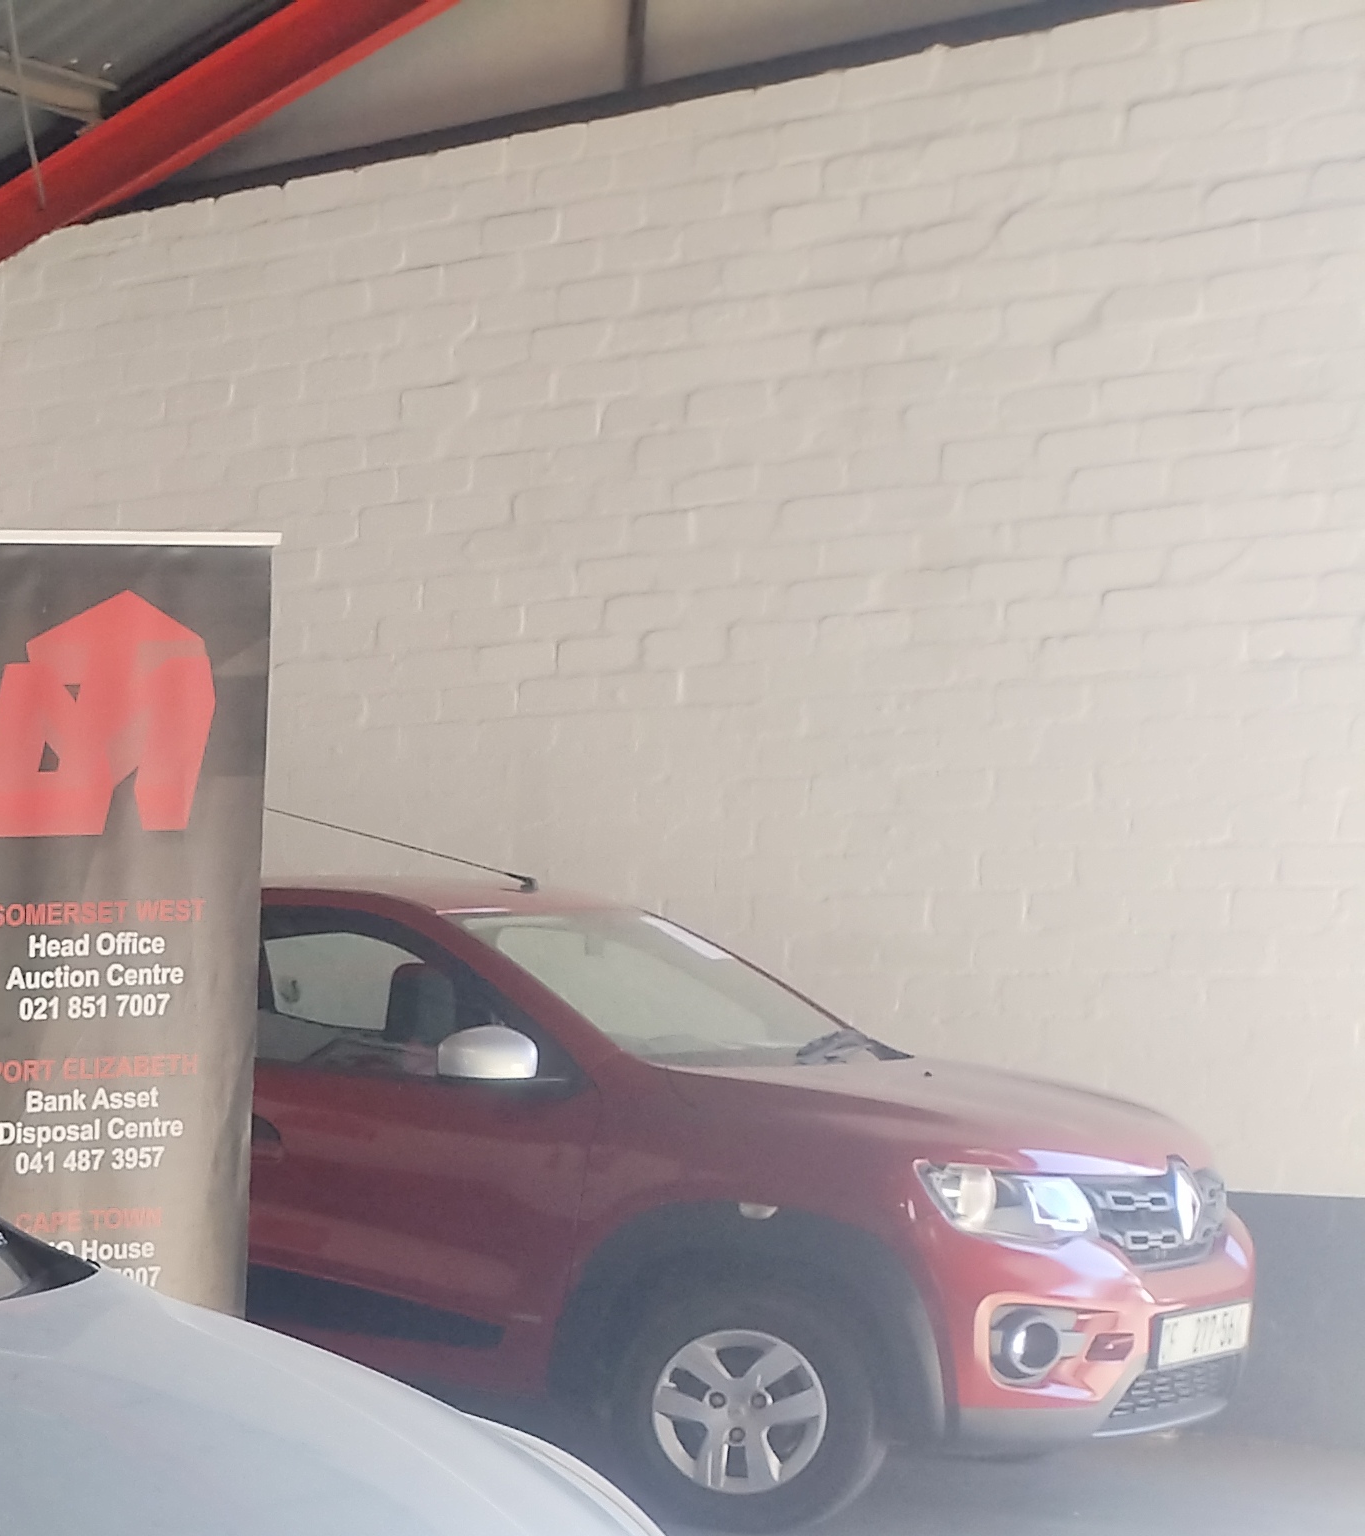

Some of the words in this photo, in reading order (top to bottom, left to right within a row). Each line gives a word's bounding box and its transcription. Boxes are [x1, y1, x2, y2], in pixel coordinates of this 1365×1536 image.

[137, 898, 206, 922] WEST
[28, 933, 89, 958] Head
[96, 931, 165, 956] Office
[5, 965, 99, 990] Auction
[106, 963, 184, 987] Centre
[18, 996, 59, 1021] 021
[67, 995, 107, 1019] 851
[116, 993, 170, 1017] 7007
[63, 1054, 198, 1080] ELIZABETH
[26, 1088, 87, 1113] Bank
[92, 1086, 159, 1110] Asset
[107, 1116, 183, 1140] Centre
[15, 1150, 54, 1175] 041
[63, 1148, 105, 1172] 487
[111, 1146, 164, 1170] 3957
[15, 1209, 82, 1234] CAPE
[89, 1207, 163, 1231] TOWN
[81, 1239, 155, 1262] House
